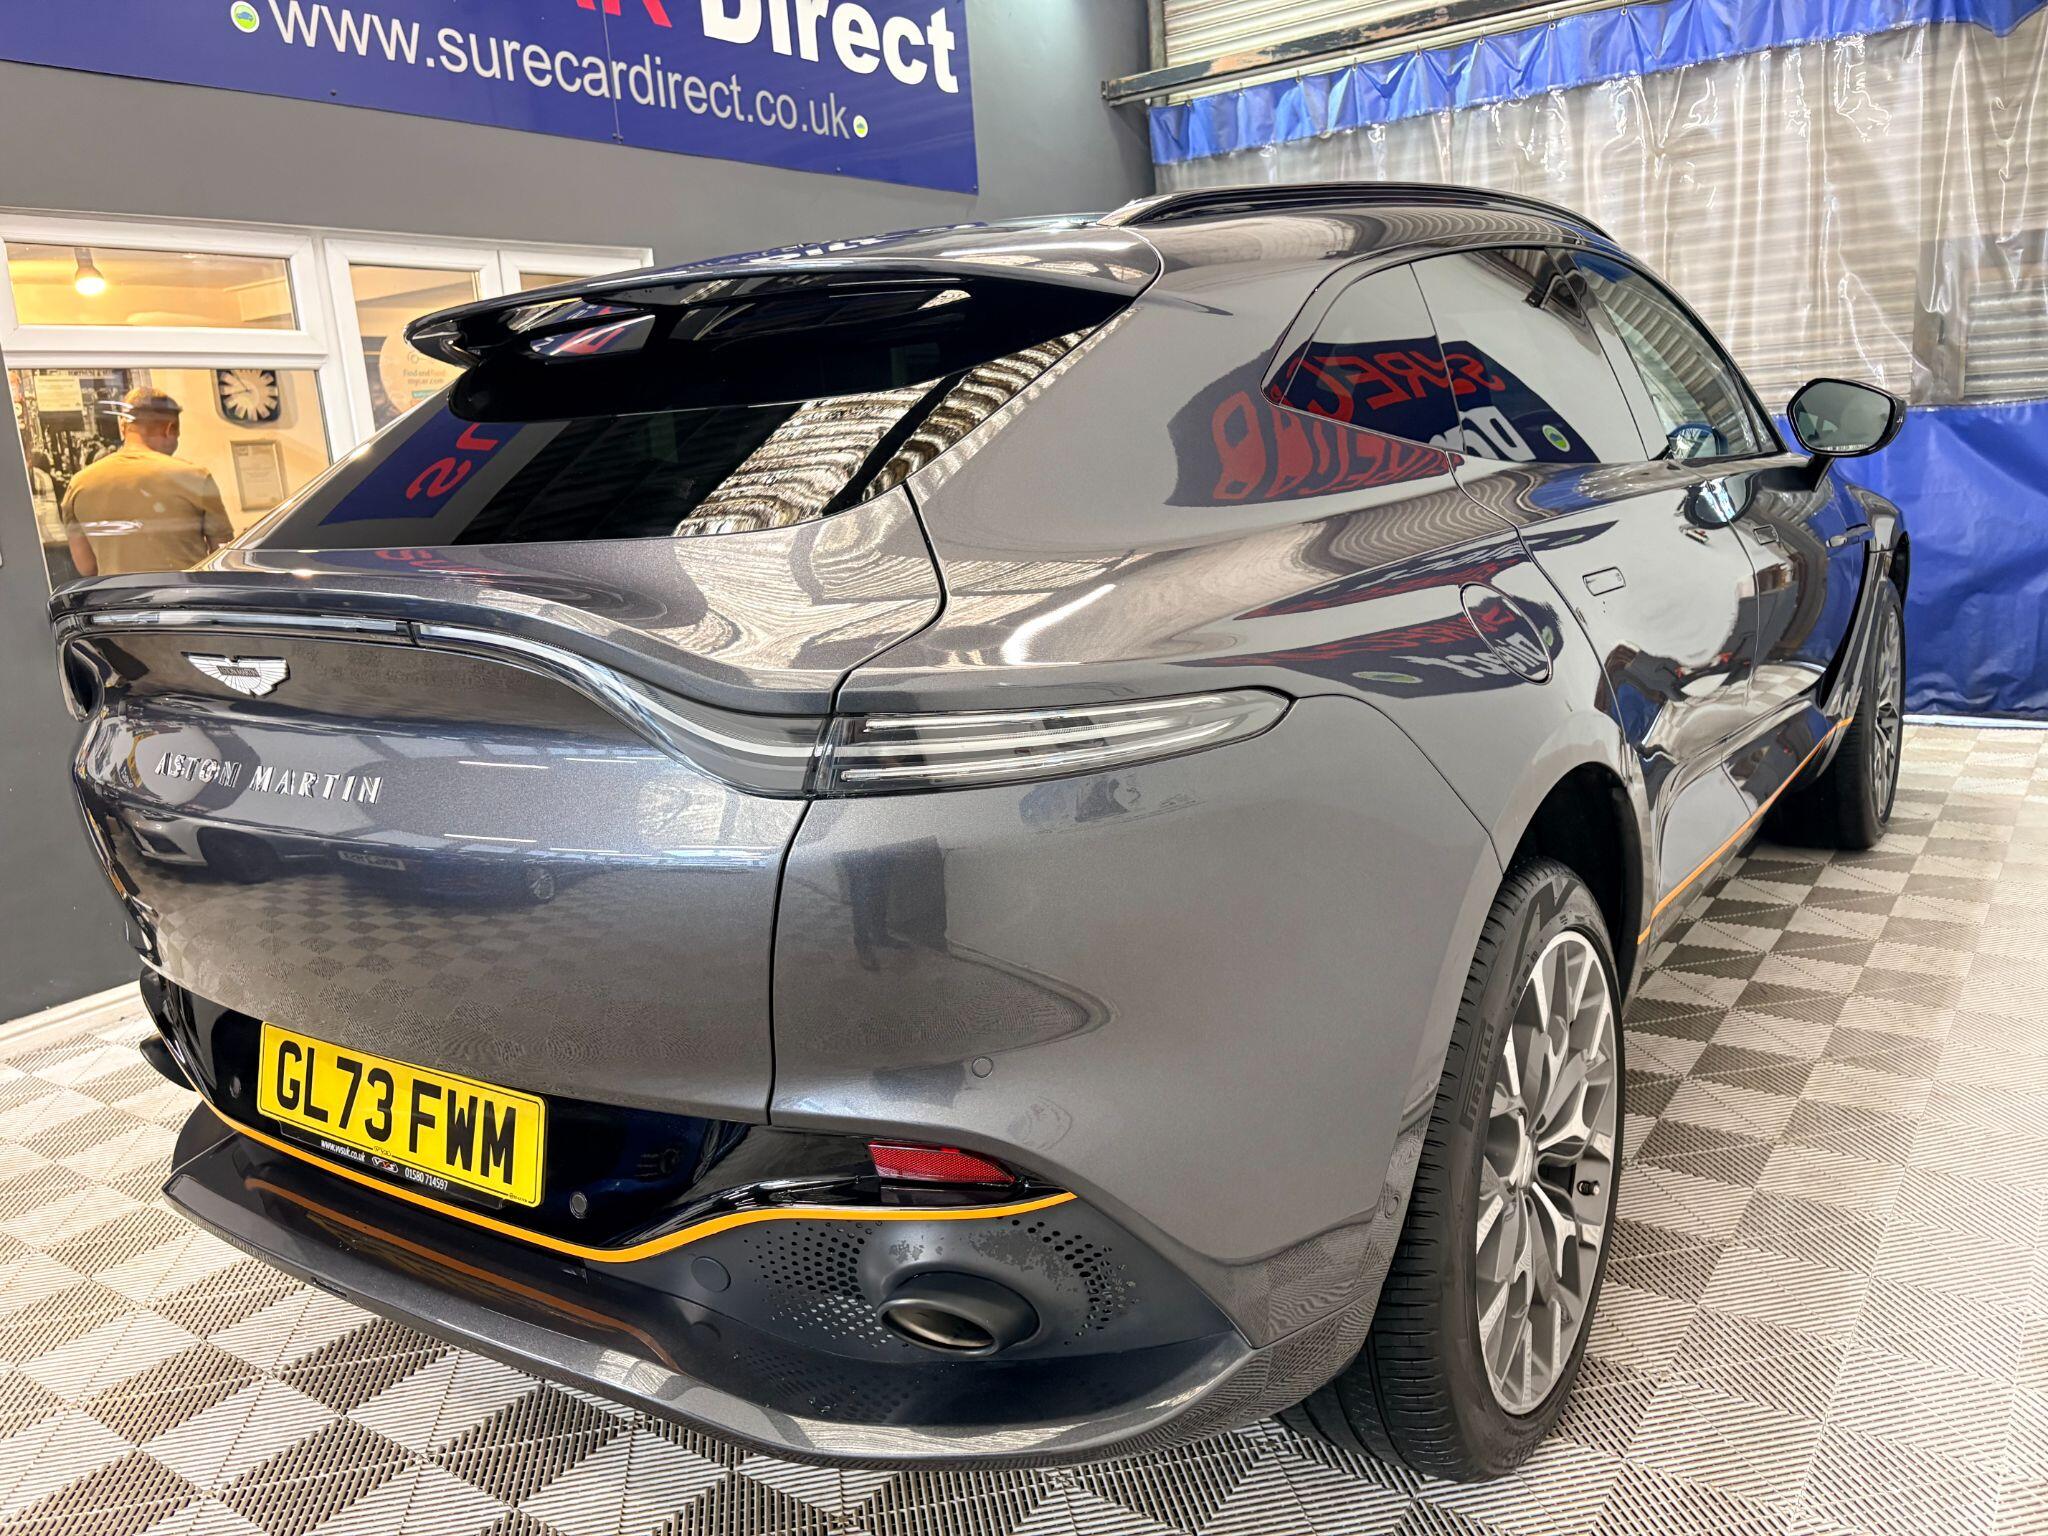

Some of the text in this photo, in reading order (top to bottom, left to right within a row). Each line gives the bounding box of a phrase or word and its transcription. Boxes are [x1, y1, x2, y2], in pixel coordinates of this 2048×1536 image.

[268, 0, 851, 139] www.surecardirect.co.uk
[155, 752, 241, 788] ASTON
[249, 765, 383, 804] MARTIN
[277, 1040, 517, 1186] GL73 FWM
[1458, 1016, 1495, 1133] PIRELLI
